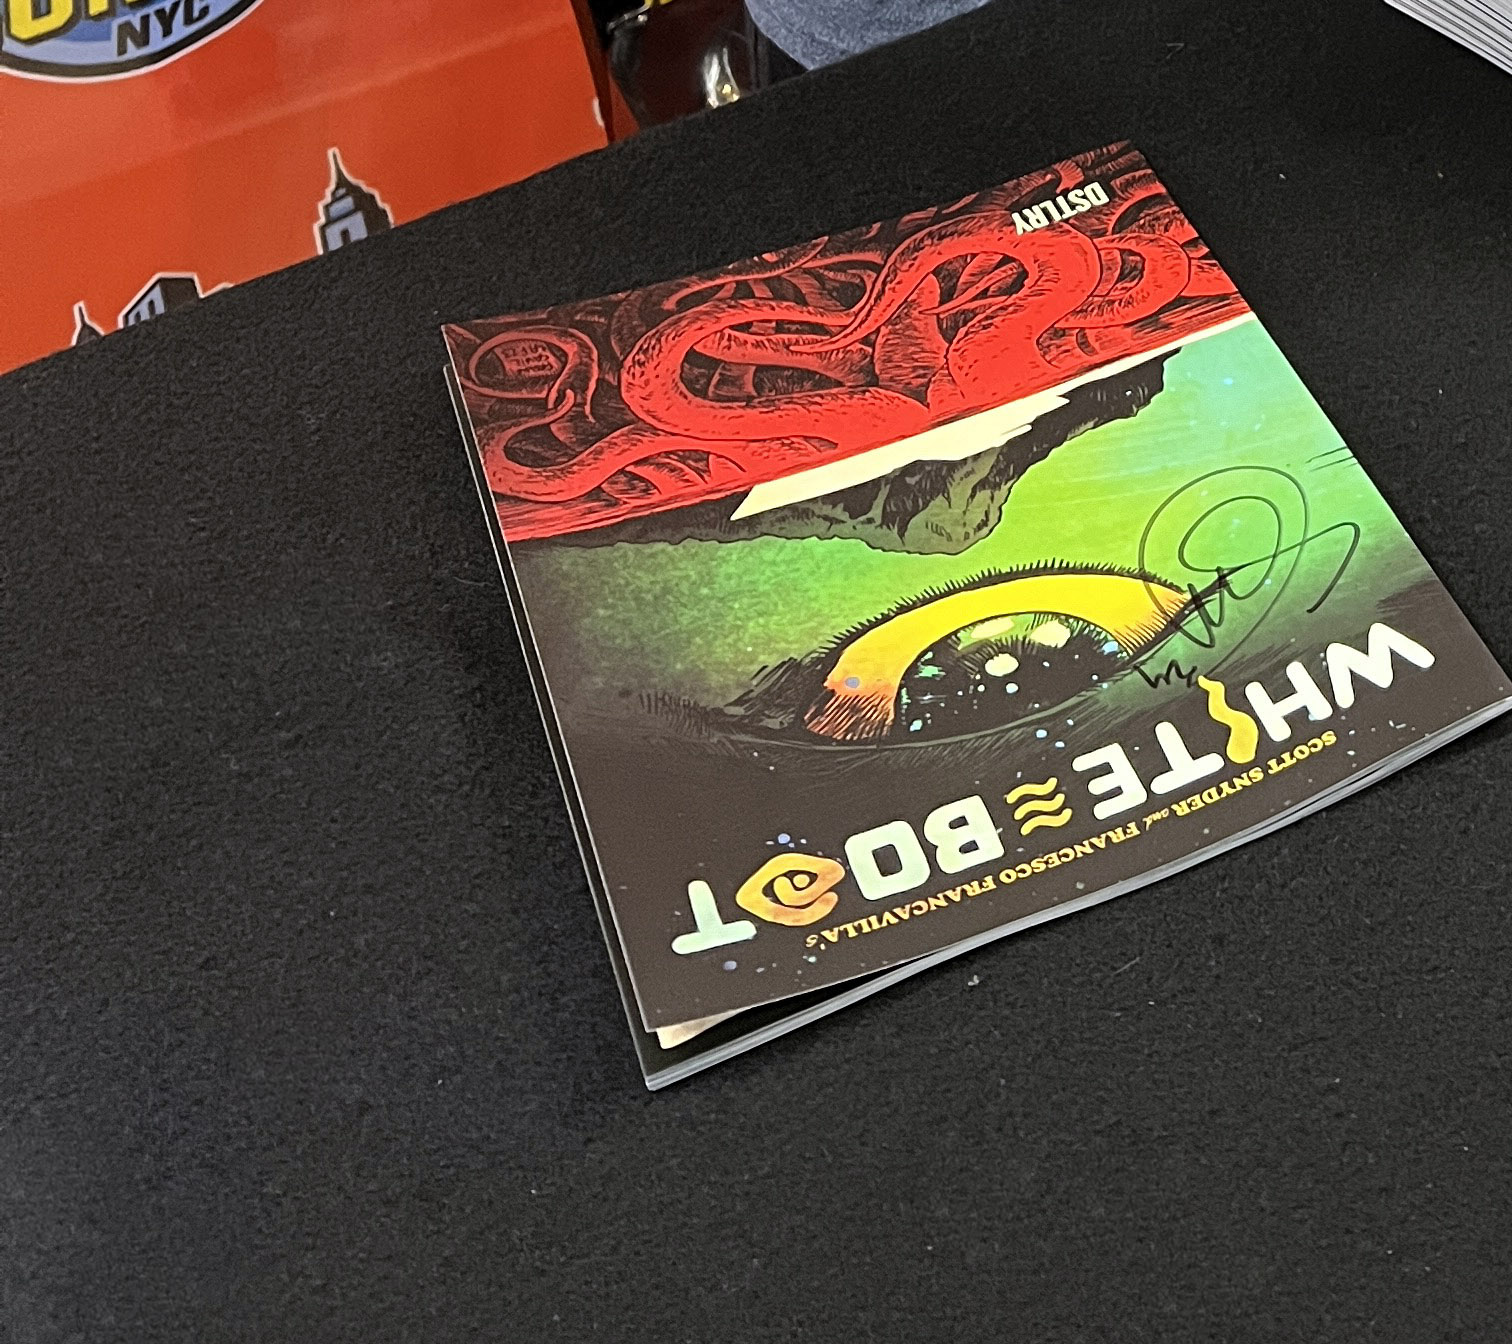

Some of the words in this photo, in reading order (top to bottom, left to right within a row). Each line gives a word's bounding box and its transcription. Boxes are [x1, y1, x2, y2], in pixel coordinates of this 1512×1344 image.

[1011, 181, 1110, 236] DSTLRY
[1268, 730, 1337, 775] SCOTT
[1171, 764, 1265, 817] SNYDER
[999, 822, 1141, 884] FRANCESCO
